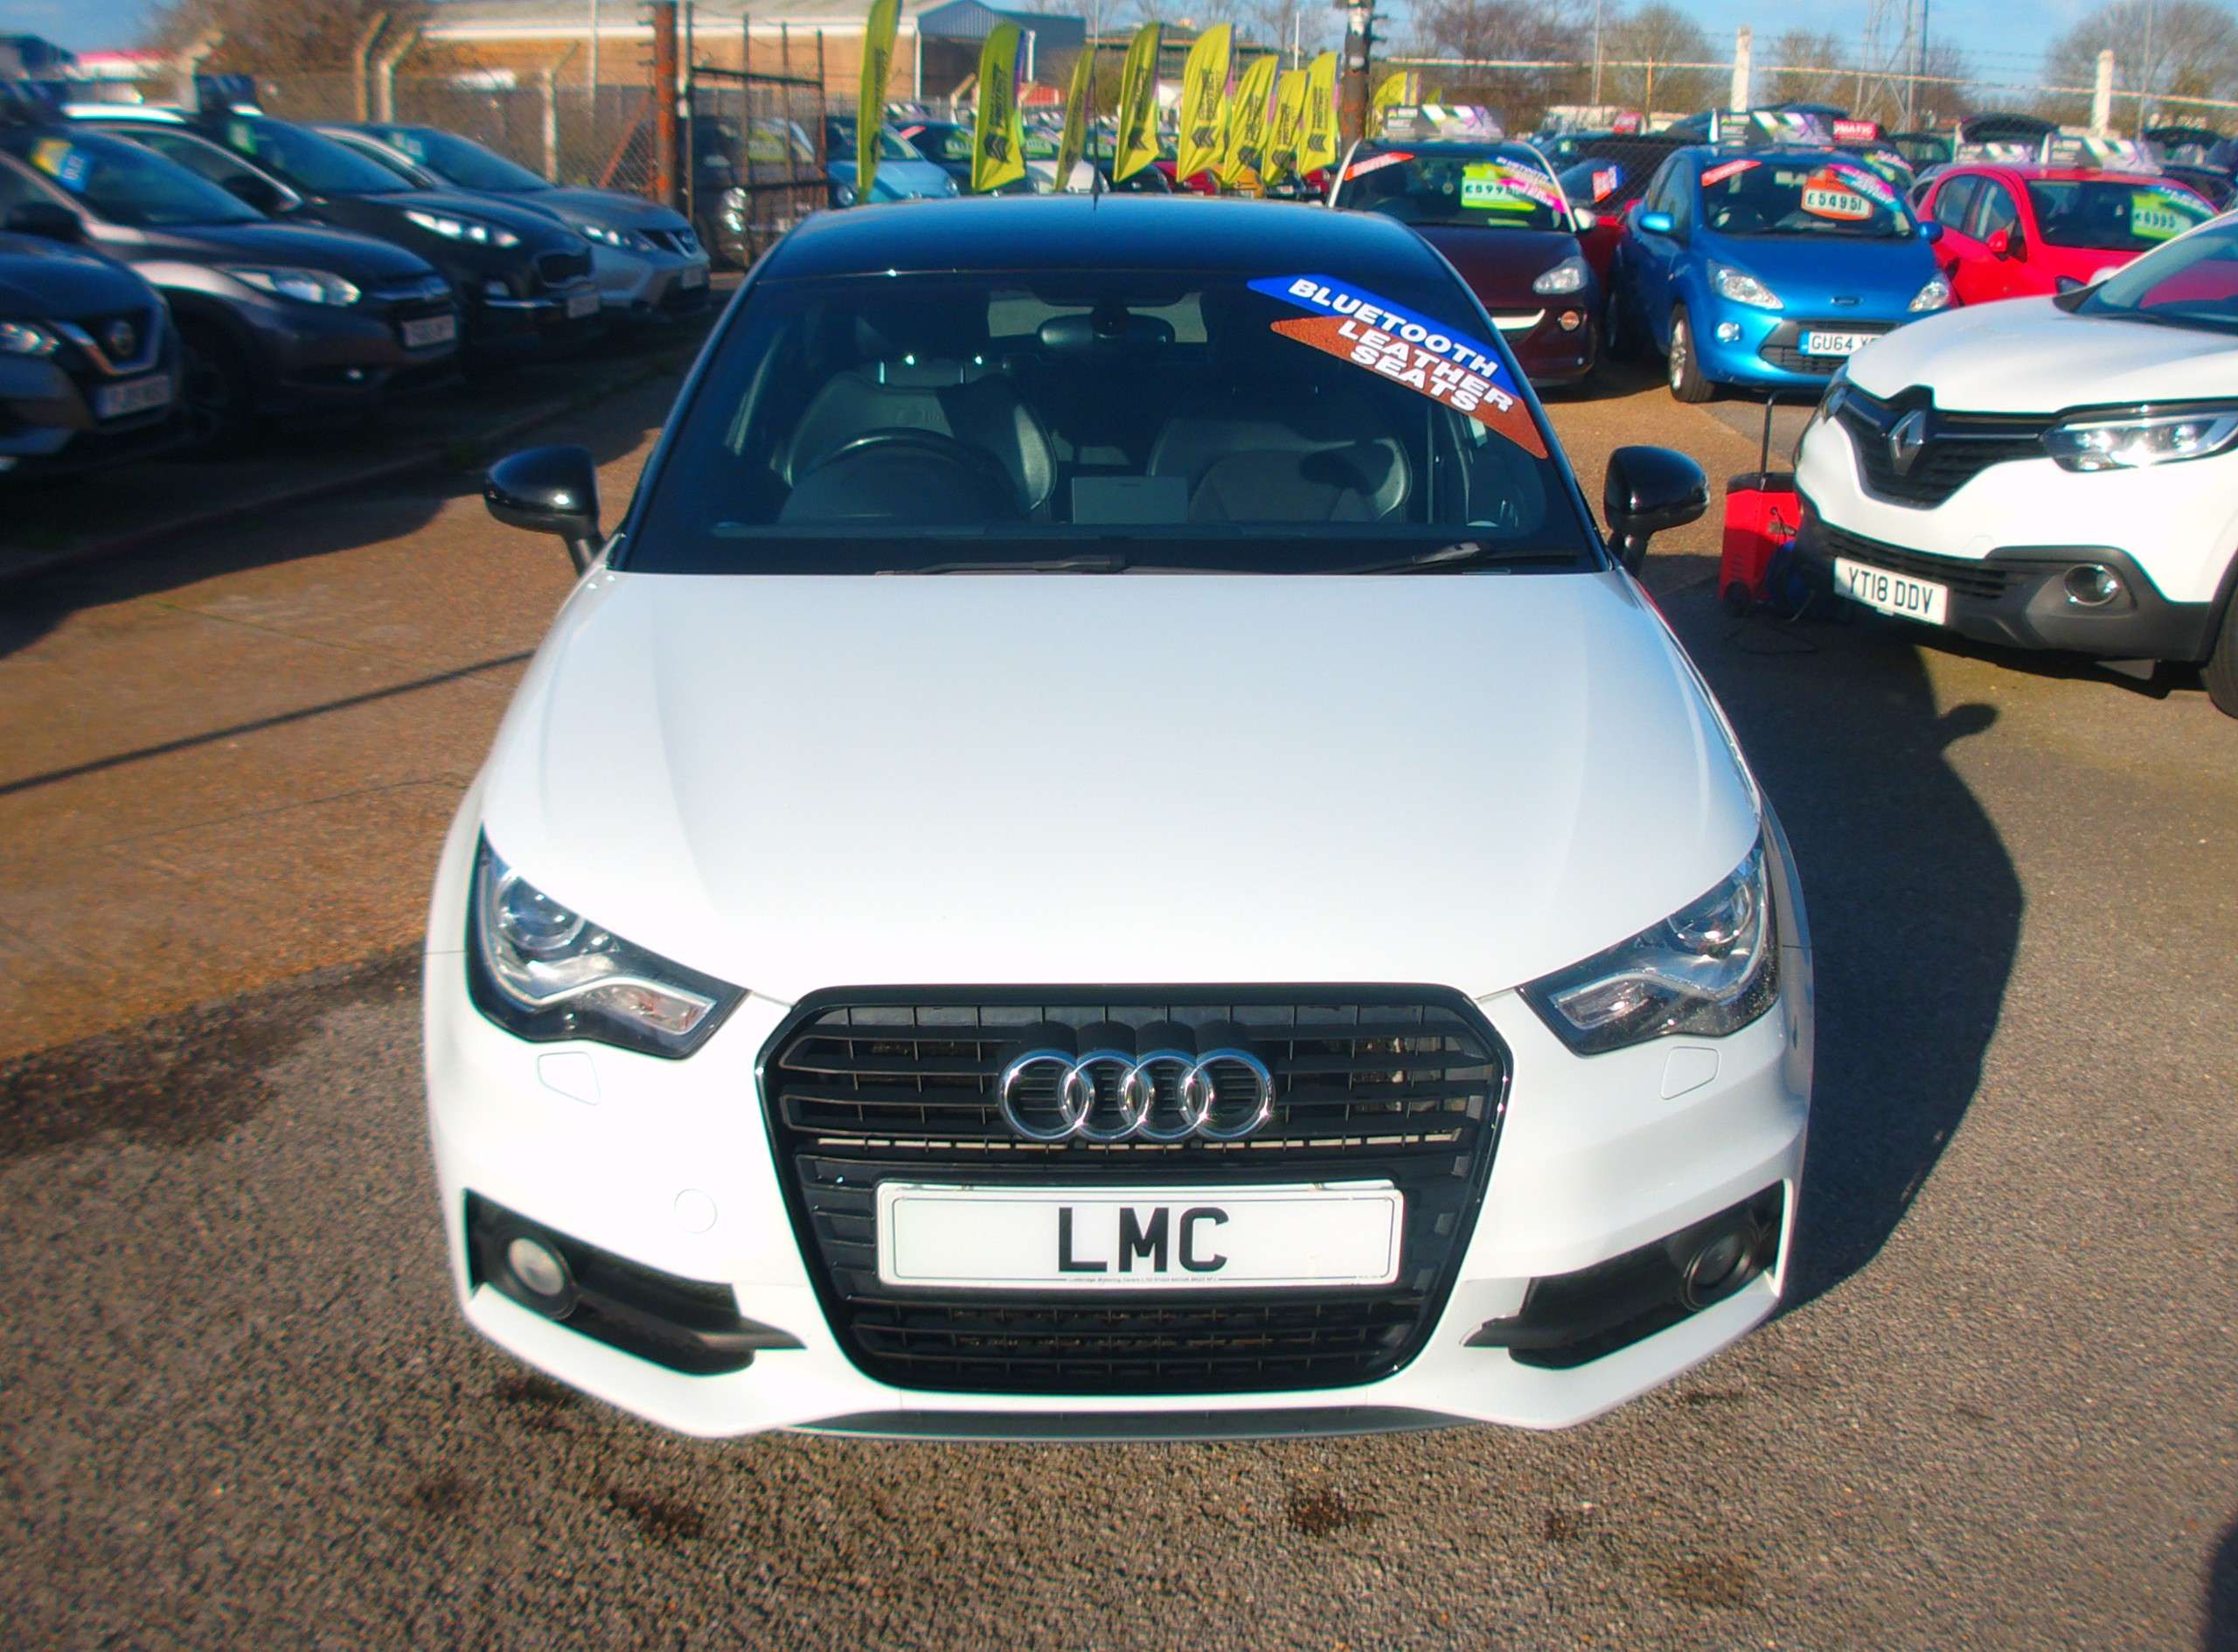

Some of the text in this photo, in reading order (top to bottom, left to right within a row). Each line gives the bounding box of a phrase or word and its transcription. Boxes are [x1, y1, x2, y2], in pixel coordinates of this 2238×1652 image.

[1288, 278, 1498, 378] BLUETOOTH
[1812, 335, 1853, 351] GU64
[1338, 320, 1514, 412] LEATHER
[1350, 345, 1480, 412] SEATS
[1849, 566, 1933, 614] YT18 DDV
[1059, 1207, 1229, 1273] LMC
